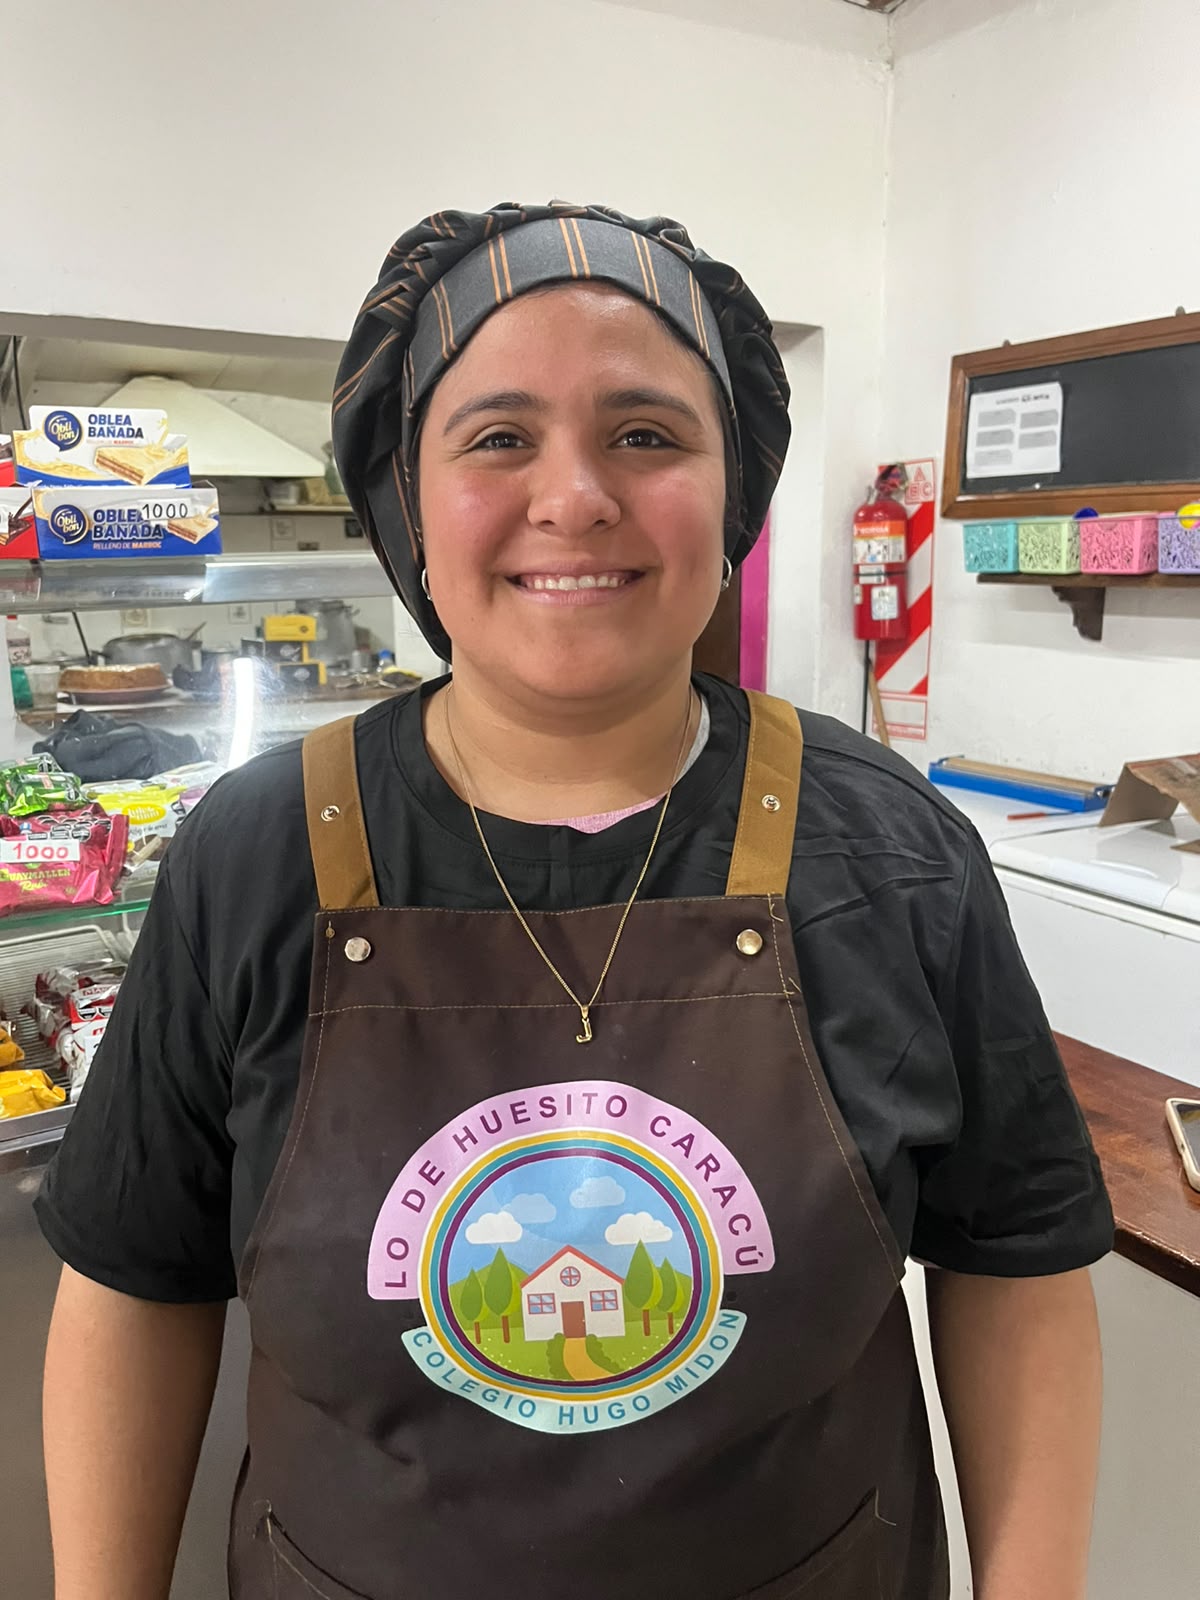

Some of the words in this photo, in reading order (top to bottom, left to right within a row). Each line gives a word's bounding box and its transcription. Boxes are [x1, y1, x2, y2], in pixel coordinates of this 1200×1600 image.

[88, 414, 132, 426] OBLEA
[57, 430, 75, 441] bon
[88, 426, 144, 439] BAÑADA
[142, 503, 188, 519] 1000
[63, 522, 79, 533] bon
[93, 524, 162, 539] BAÑADA
[93, 542, 121, 550] RELLENO
[13, 843, 69, 859] 1000
[384, 1237, 410, 1288] LO
[401, 1159, 446, 1214] DE
[452, 1092, 628, 1153] HUESITO
[650, 1115, 764, 1267] CARACÚ
[413, 1331, 536, 1418] COLEGIO
[558, 1395, 651, 1425] HUGO
[665, 1312, 740, 1395] MIDON
